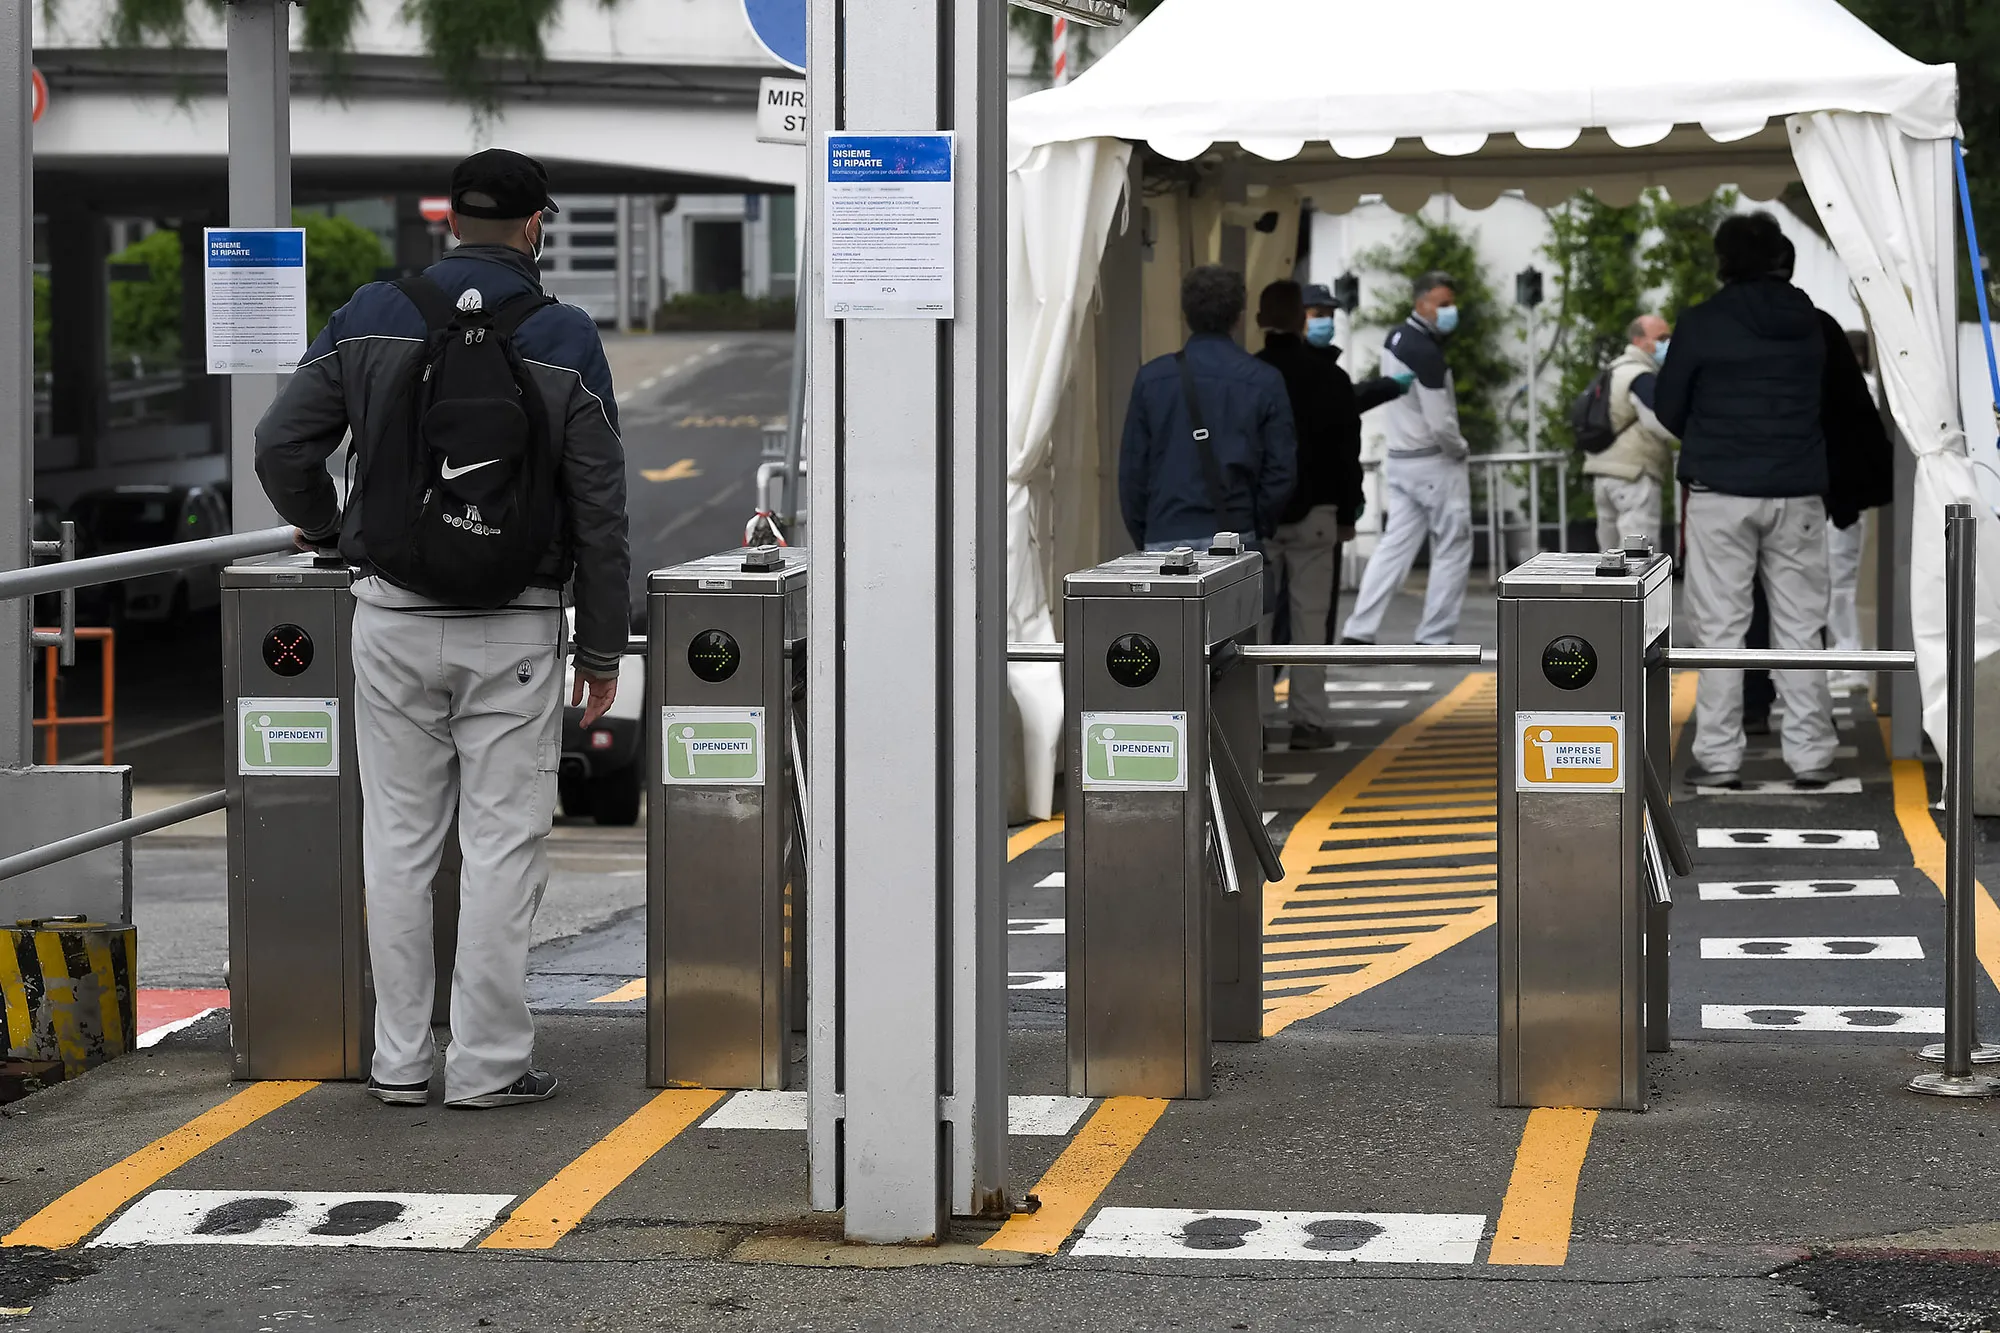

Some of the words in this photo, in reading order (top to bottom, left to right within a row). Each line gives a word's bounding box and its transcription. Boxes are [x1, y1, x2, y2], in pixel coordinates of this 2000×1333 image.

[768, 89, 806, 108] MIR
[832, 150, 871, 158] INSIEME
[832, 159, 841, 167] SI
[844, 159, 882, 167] RIPARTE
[269, 731, 323, 739] DIPENDENTI
[692, 742, 748, 750] DIPENDENTI
[1112, 744, 1170, 753] DIPENDENTI
[1556, 746, 1601, 754] IMPRESE
[1556, 756, 1602, 764] ESTERNE
